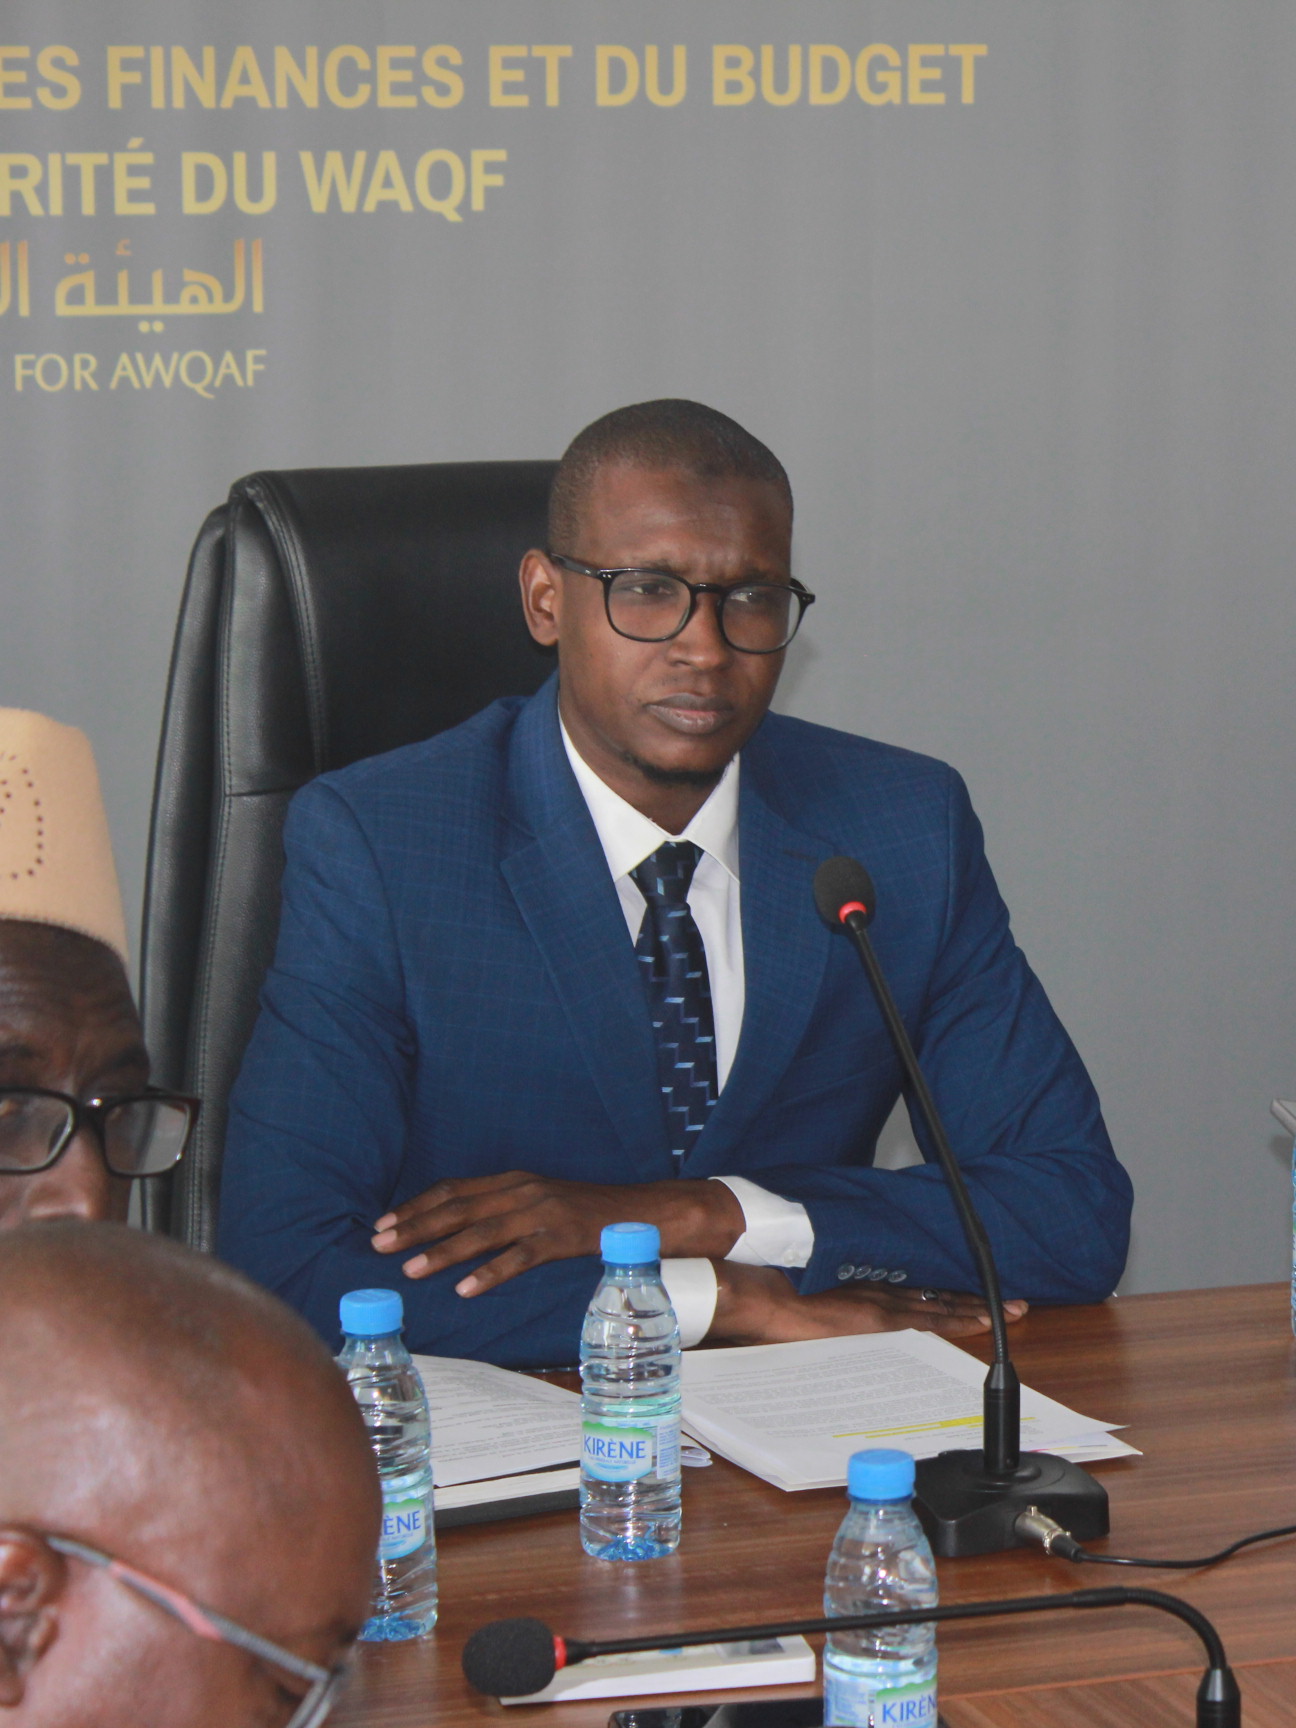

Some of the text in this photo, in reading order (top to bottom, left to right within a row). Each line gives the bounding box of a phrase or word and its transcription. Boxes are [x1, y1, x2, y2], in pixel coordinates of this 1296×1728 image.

[106, 45, 465, 110] FINANCES
[489, 45, 573, 107] ET
[595, 45, 687, 107] DU
[712, 43, 989, 107] BUDGET
[181, 151, 277, 215] DU
[299, 149, 508, 222] WAQF
[55, 238, 264, 333] الهيئة
[14, 349, 267, 399] FOR AWQAF
[583, 1434, 646, 1459] KIRÈNE
[383, 1510, 421, 1536] ÈNE
[881, 1695, 937, 1723] KIRÈN
